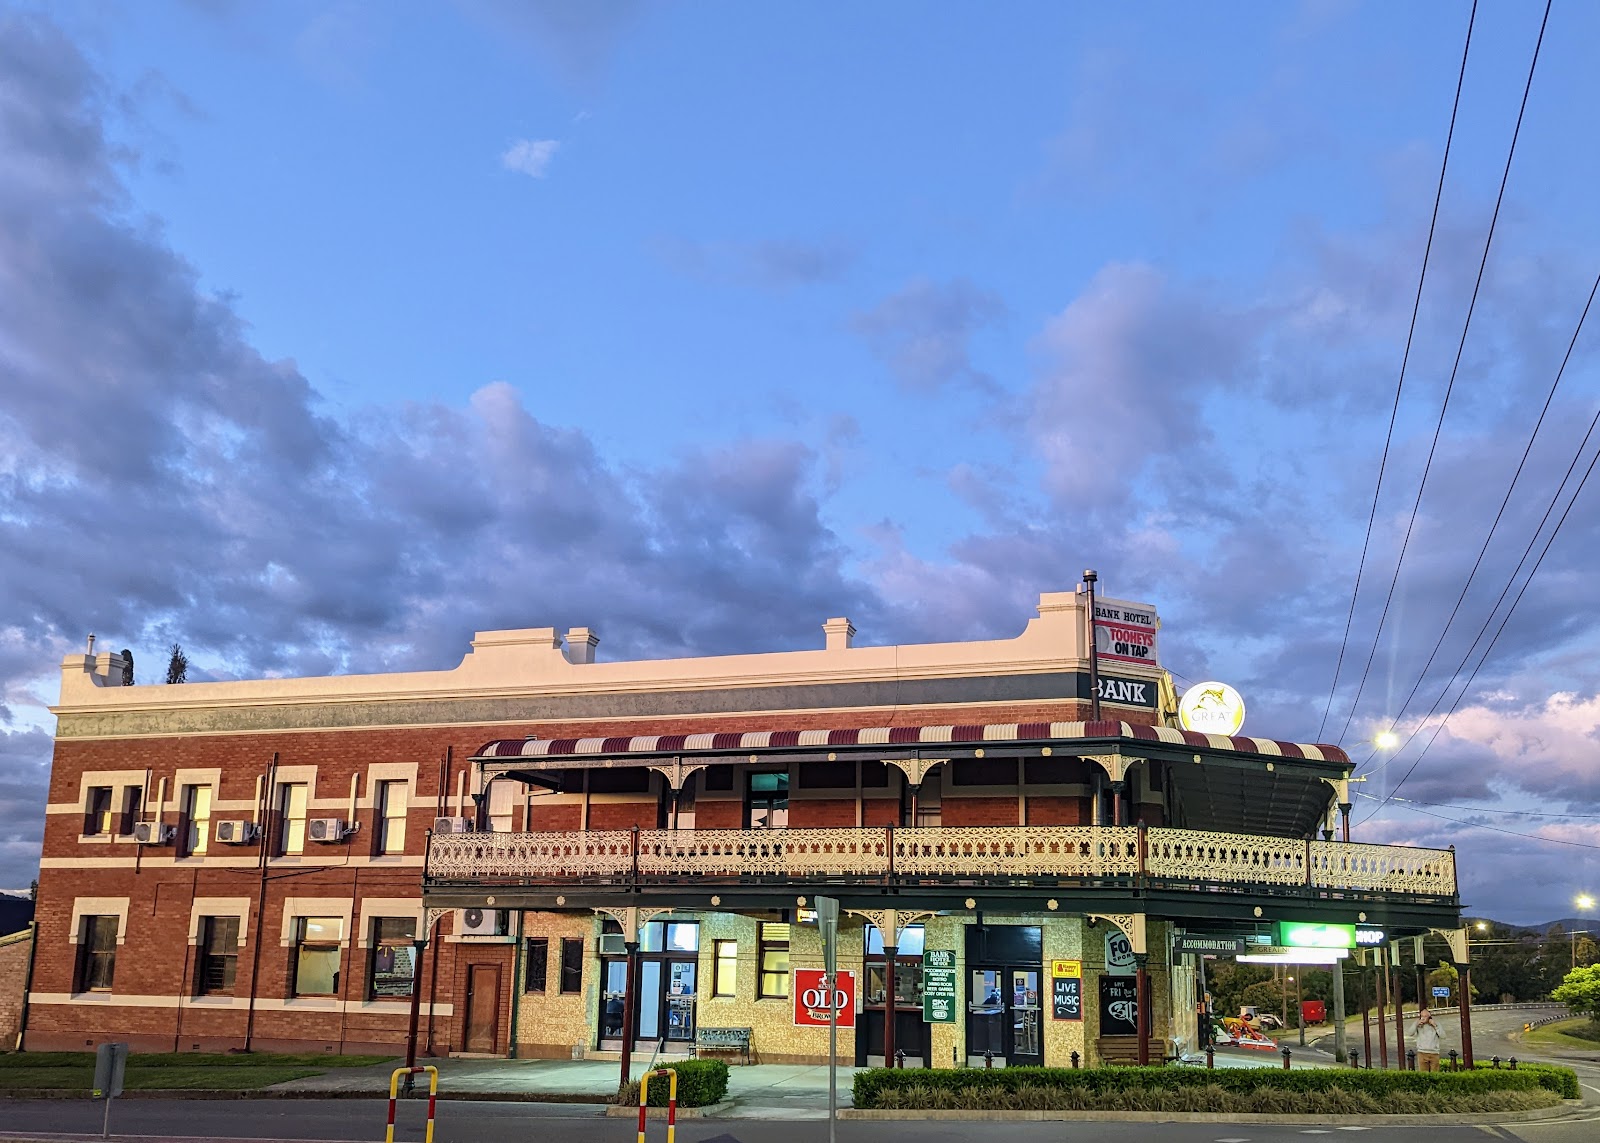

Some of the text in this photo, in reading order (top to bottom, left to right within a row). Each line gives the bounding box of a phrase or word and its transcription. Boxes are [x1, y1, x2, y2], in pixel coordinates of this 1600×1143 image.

[1095, 607, 1152, 625] BANK HOTEL
[1110, 629, 1153, 646] TOOHEYS
[1114, 642, 1148, 658] ON TAP
[1191, 711, 1233, 722] GREAT
[1182, 939, 1237, 951] ACCOMMODATION
[1056, 982, 1077, 994] LIVE
[1110, 987, 1121, 997] FRI
[802, 988, 849, 1009] OLD
[1054, 994, 1080, 1006] MUSIC
